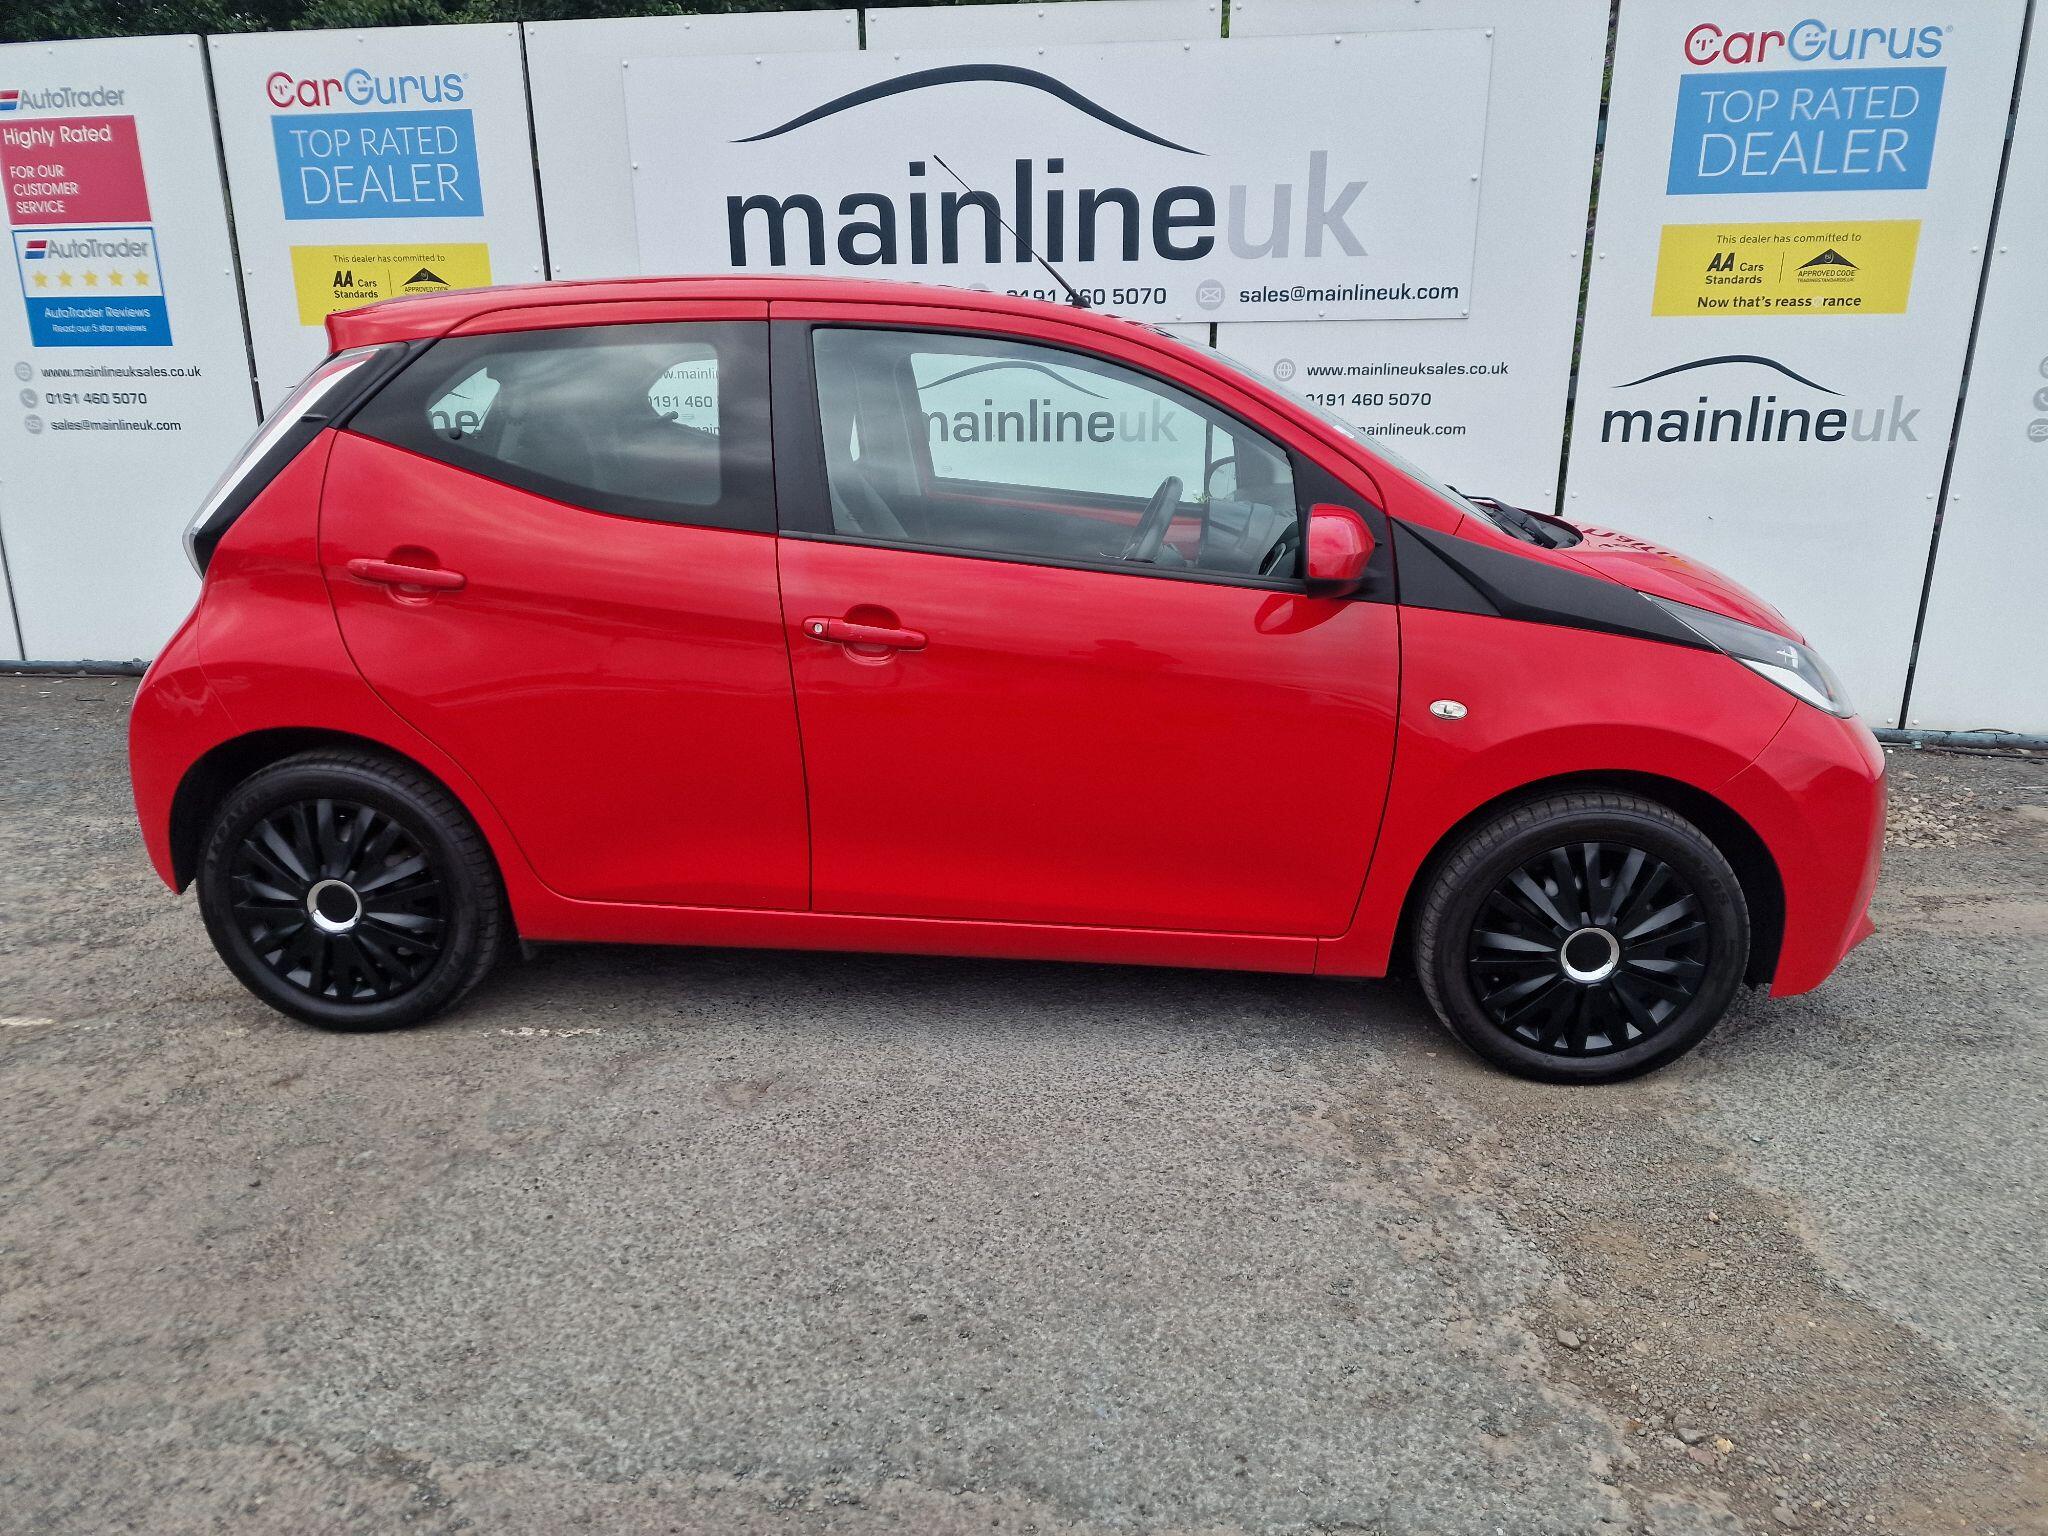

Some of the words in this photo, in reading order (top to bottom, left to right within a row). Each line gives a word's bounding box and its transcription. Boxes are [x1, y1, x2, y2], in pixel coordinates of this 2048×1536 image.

[1684, 19, 1944, 66] CarGurus
[266, 68, 465, 108] CarGurus
[20, 86, 125, 110] AutoTrader
[1701, 89, 1779, 124] TOP
[1790, 85, 1919, 121] RATED
[3, 127, 54, 149] Highly
[60, 124, 112, 143] Rated
[289, 129, 350, 158] TOP
[360, 126, 458, 156] RATED
[1697, 128, 1909, 177] DEALER
[10, 165, 34, 179] FOR
[37, 164, 65, 178] OUR
[13, 182, 79, 196] CUSTOMER
[300, 163, 465, 204] DEALER
[16, 200, 66, 214] SERVICE
[1716, 234, 1737, 244] This
[1740, 234, 1771, 243] dealer
[1774, 234, 1791, 243] has
[1793, 232, 1848, 243] committed
[1850, 232, 1862, 242] to
[48, 238, 149, 258] AutoTrader
[333, 255, 350, 263] This
[352, 255, 375, 263] dealer
[378, 255, 391, 263] has
[393, 254, 436, 263] committed
[437, 254, 445, 262] to
[1707, 252, 1735, 272] AA
[1740, 262, 1764, 272] Cars
[333, 270, 353, 288] AA
[358, 278, 377, 288] Cars
[1705, 275, 1762, 285] Standards
[334, 290, 379, 299] Standards
[1112, 287, 1167, 305] 5070
[1239, 283, 1459, 303] sales@mainlineuk.com
[1697, 297, 1729, 308] Now
[1733, 296, 1771, 307] that's
[1775, 296, 1862, 307] reassrance
[41, 365, 202, 378] www.mainlineuksales.co.uk
[1306, 362, 1509, 376] www.mainlineuksales.co.uk
[45, 393, 80, 404] 0191
[83, 392, 109, 404] 460
[112, 392, 147, 404] 5070
[684, 395, 712, 408] 460
[1351, 393, 1384, 406] 460
[1388, 393, 1431, 406] 5070
[51, 419, 181, 431] sales@mainlineuk.com
